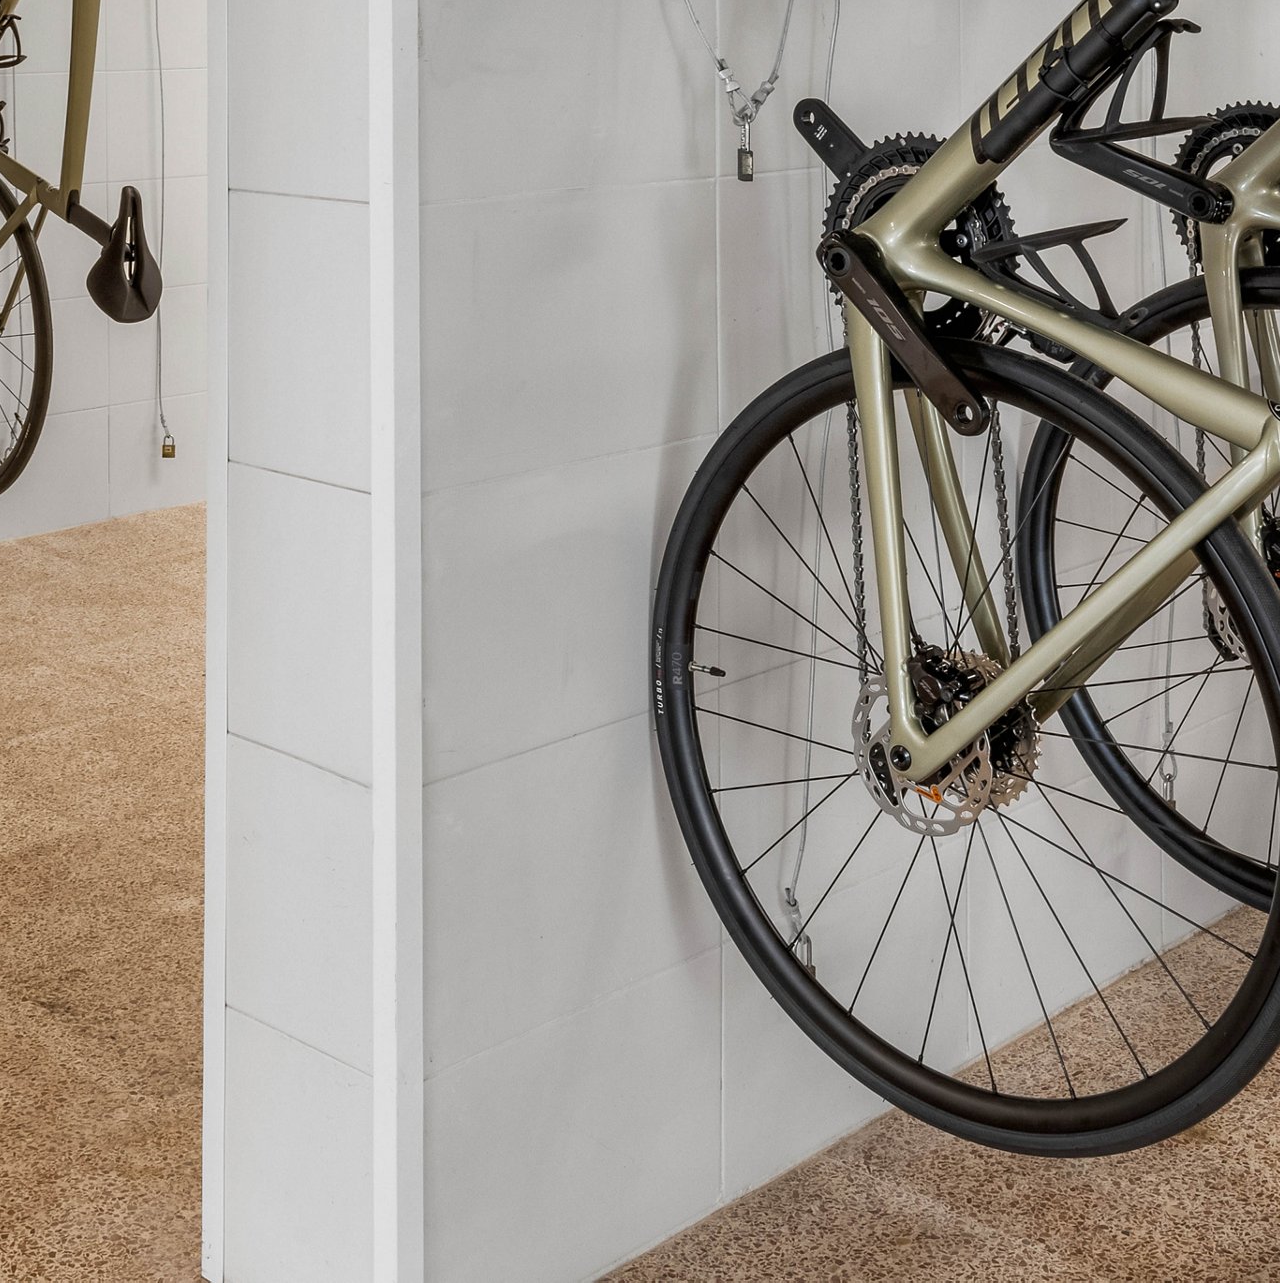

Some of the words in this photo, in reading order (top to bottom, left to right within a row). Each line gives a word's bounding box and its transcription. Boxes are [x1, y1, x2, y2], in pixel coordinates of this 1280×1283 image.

[866, 297, 907, 340] 105
[671, 651, 683, 685] R470
[655, 679, 664, 715] TURBO
